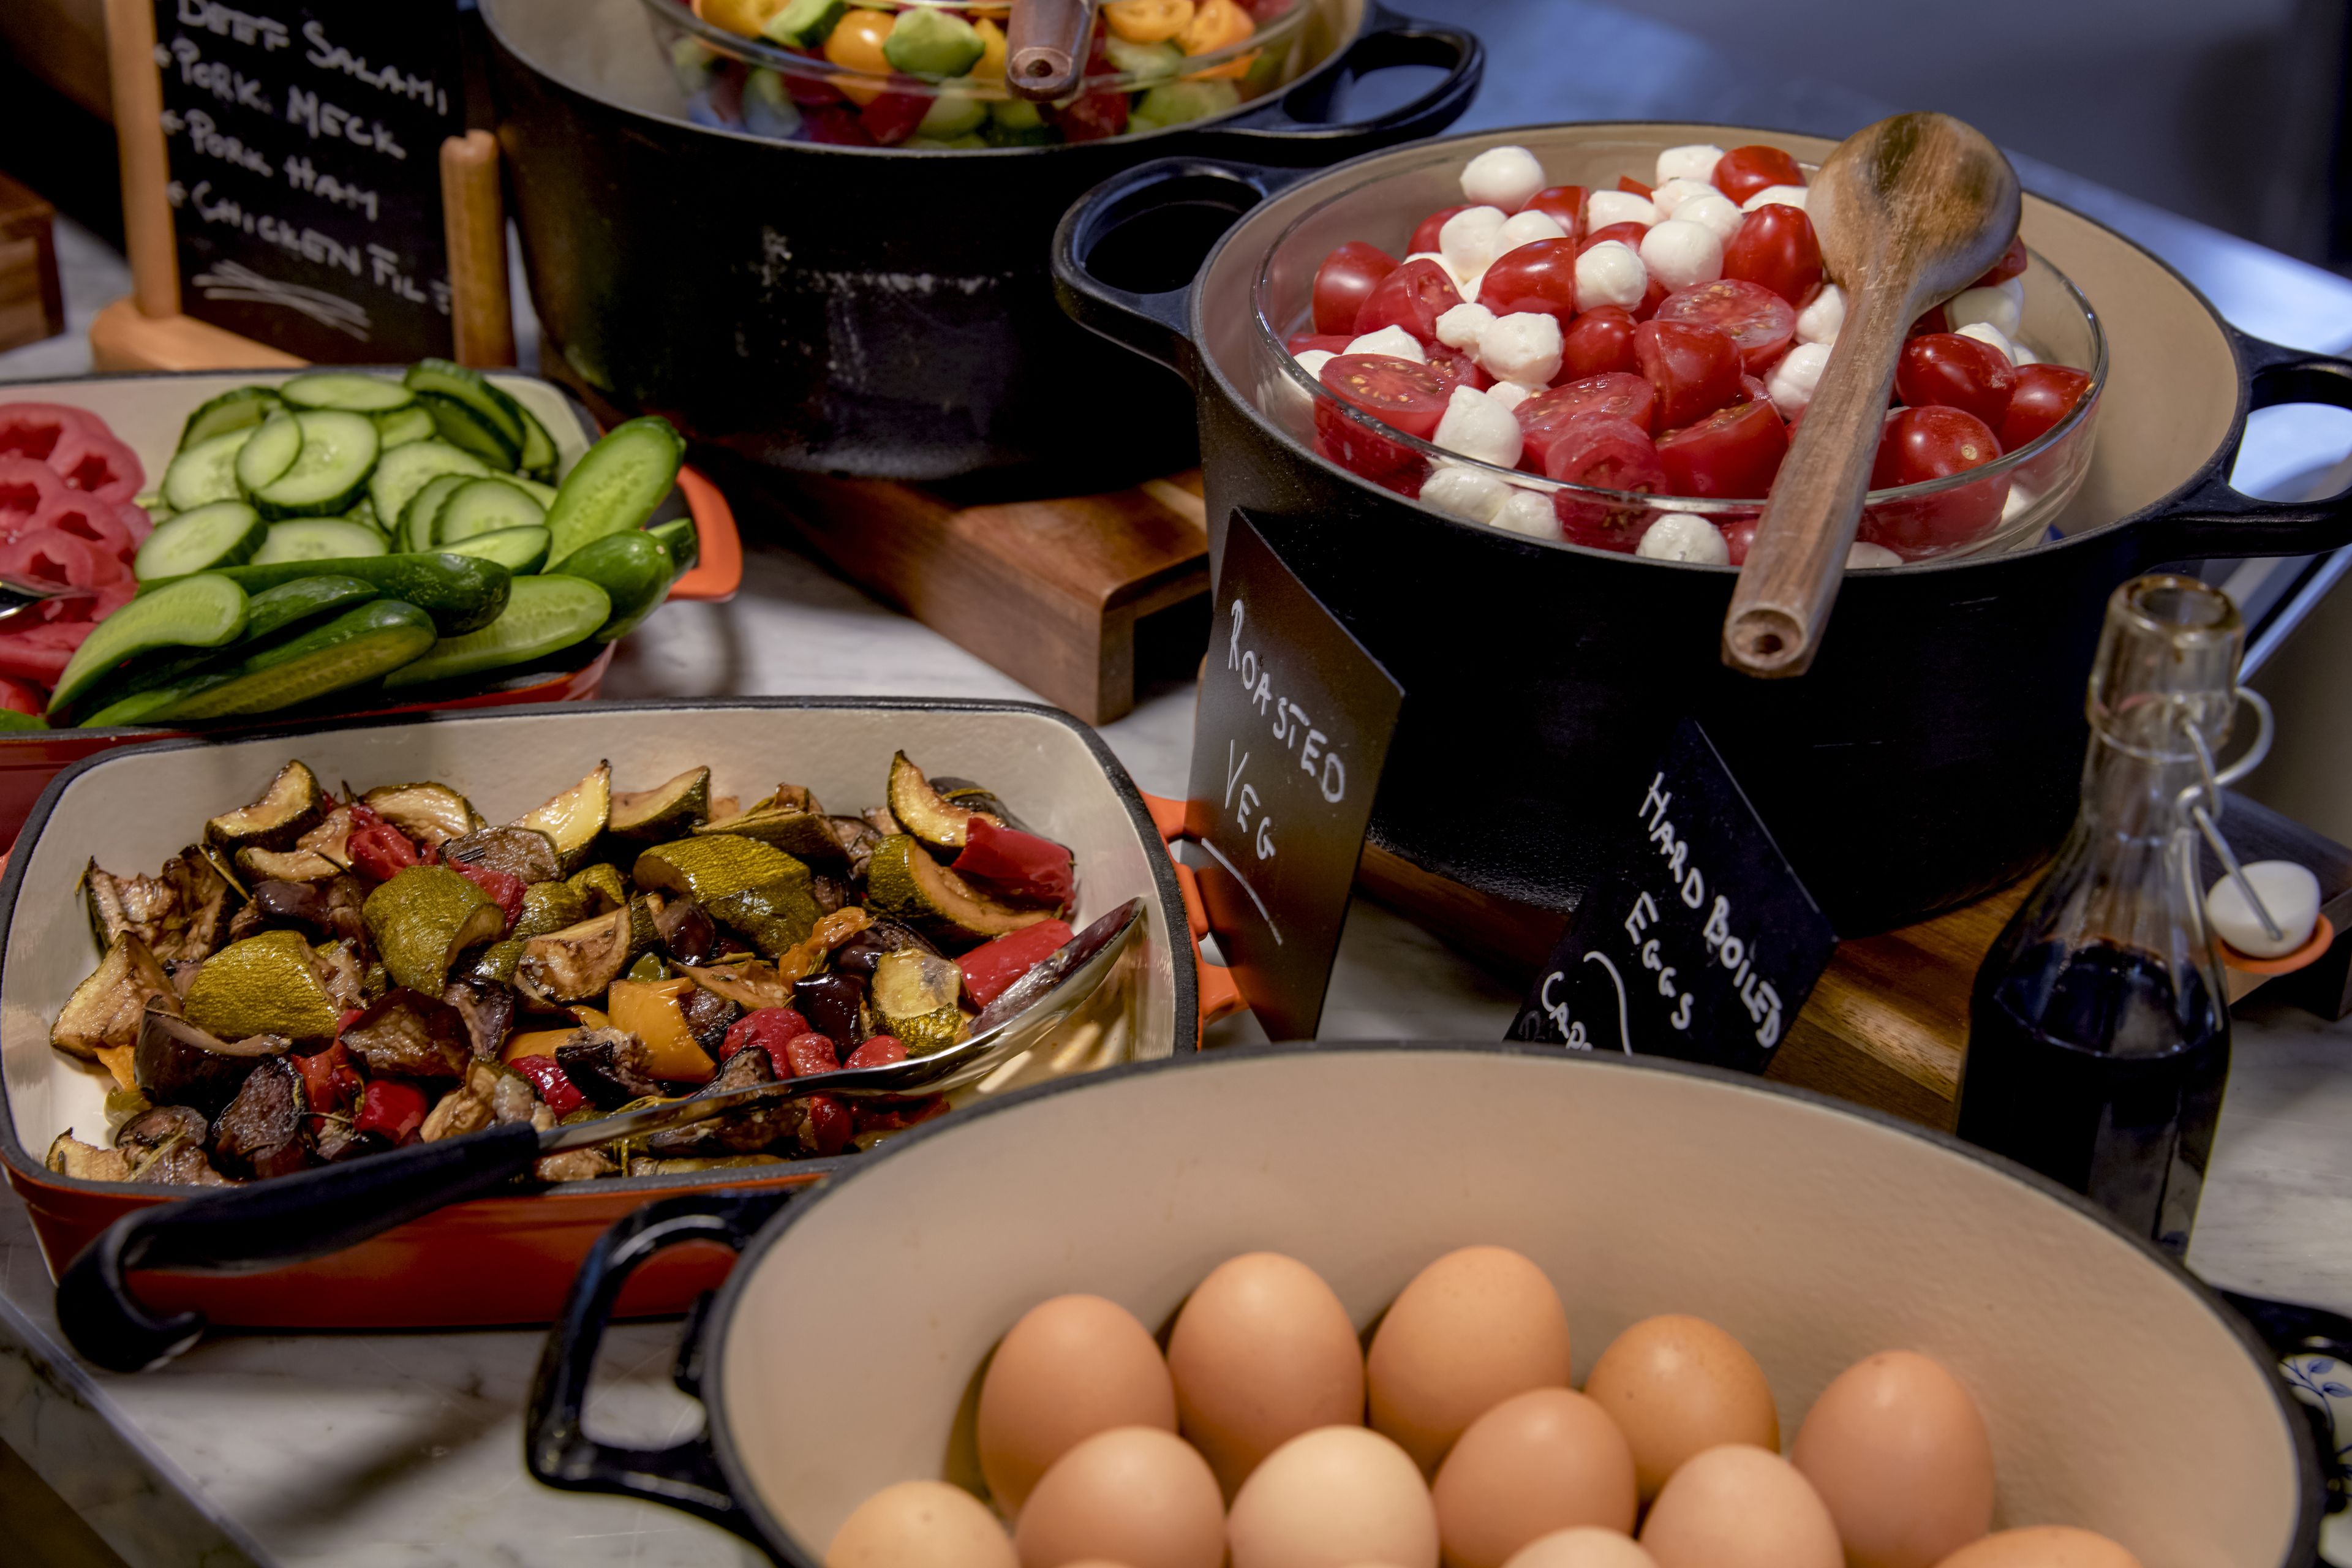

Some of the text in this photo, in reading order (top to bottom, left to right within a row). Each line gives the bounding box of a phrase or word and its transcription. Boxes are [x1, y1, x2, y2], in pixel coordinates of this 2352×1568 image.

[191, 180, 361, 276] CHICKEN
[1228, 599, 1345, 804] ROASTED
[1225, 739, 1275, 860] VEG
[1625, 891, 1694, 1030] EGGS
[1638, 772, 1782, 1047] HARD BOILED
